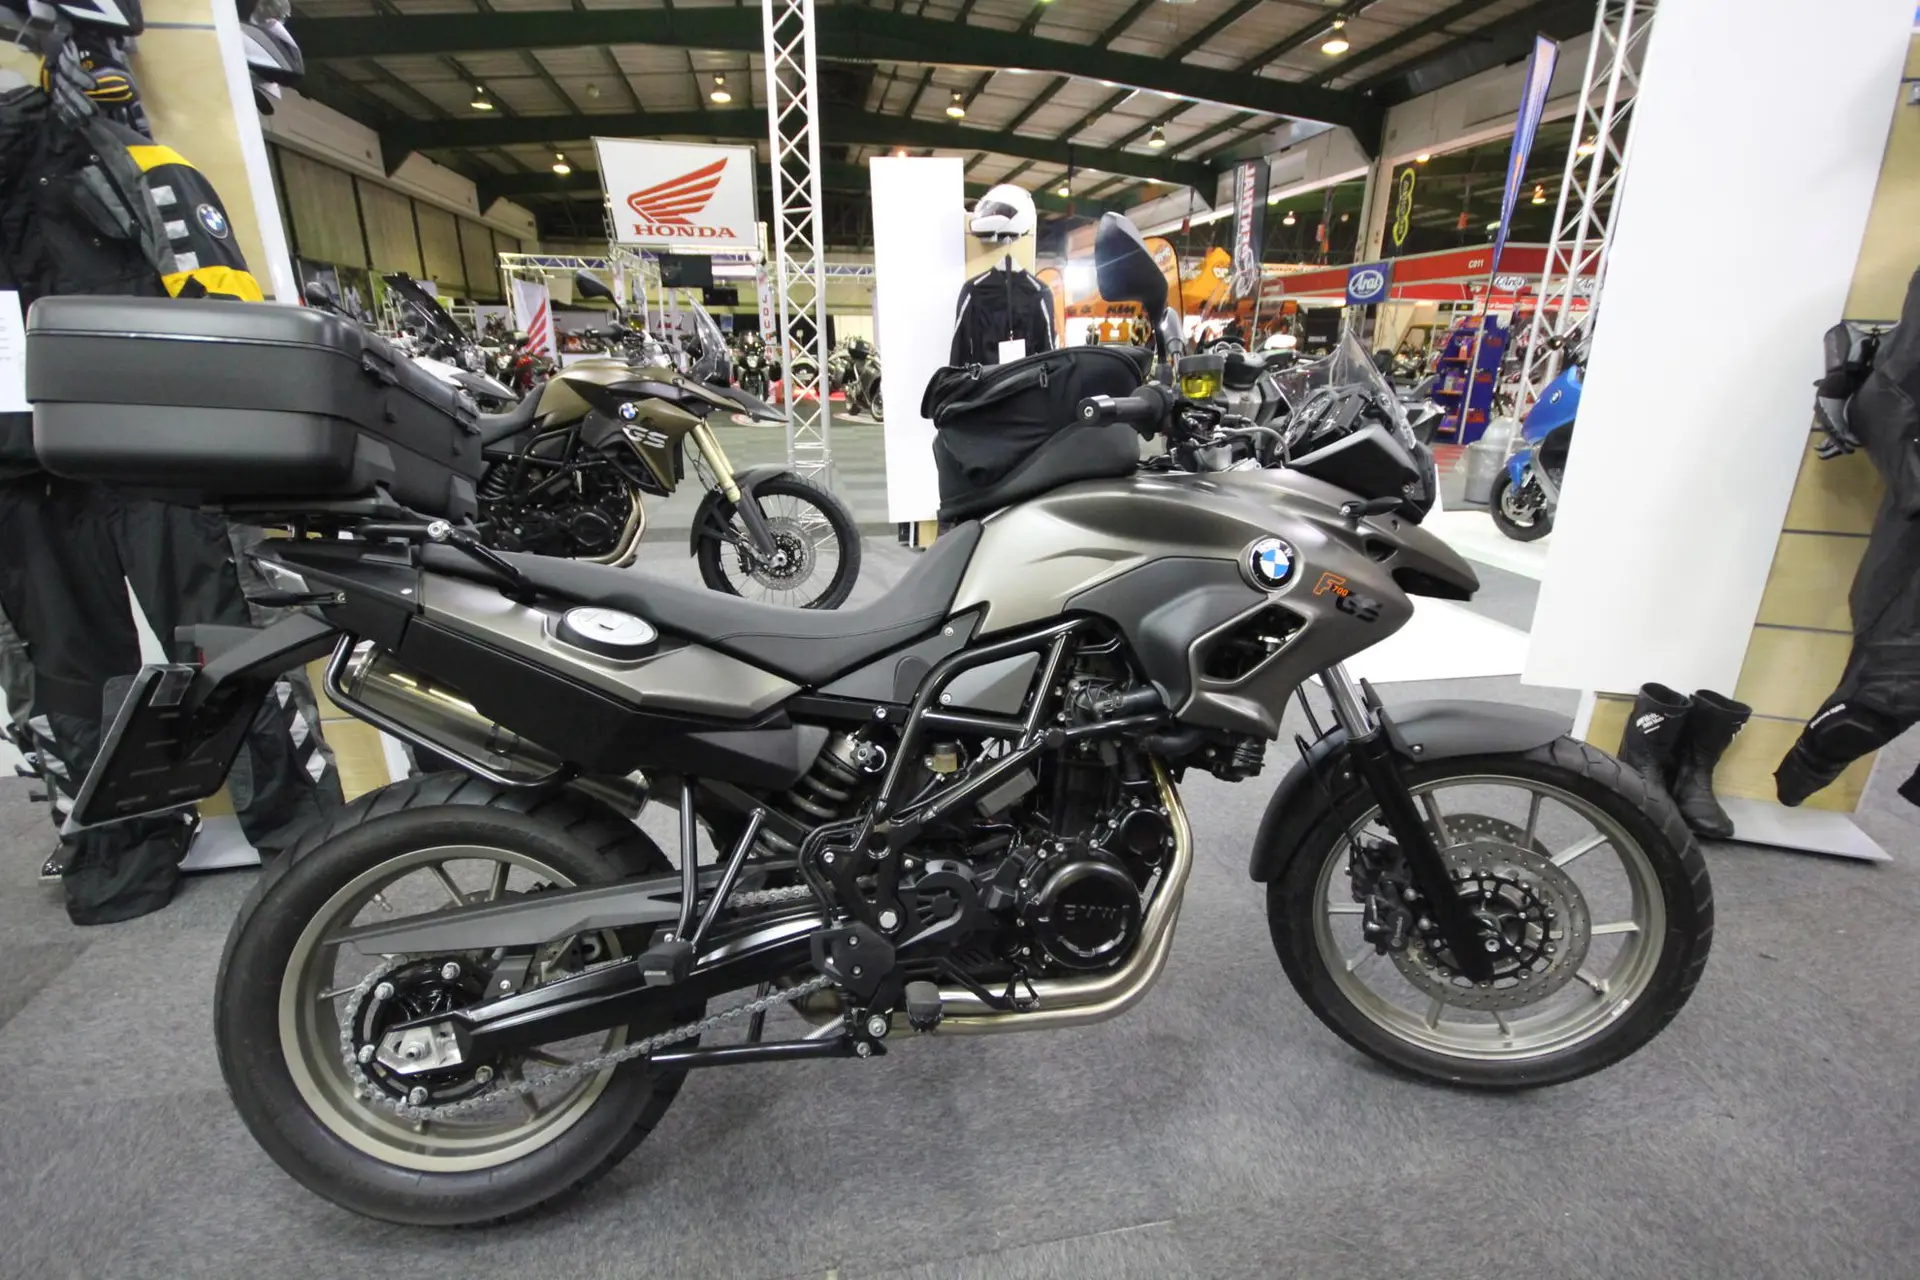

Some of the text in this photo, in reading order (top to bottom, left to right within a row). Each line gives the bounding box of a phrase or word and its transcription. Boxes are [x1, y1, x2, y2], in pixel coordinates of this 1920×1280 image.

[632, 223, 737, 239] HONDA
[622, 424, 669, 449] GS
[1312, 572, 1346, 595] F
[1331, 584, 1350, 597] 700
